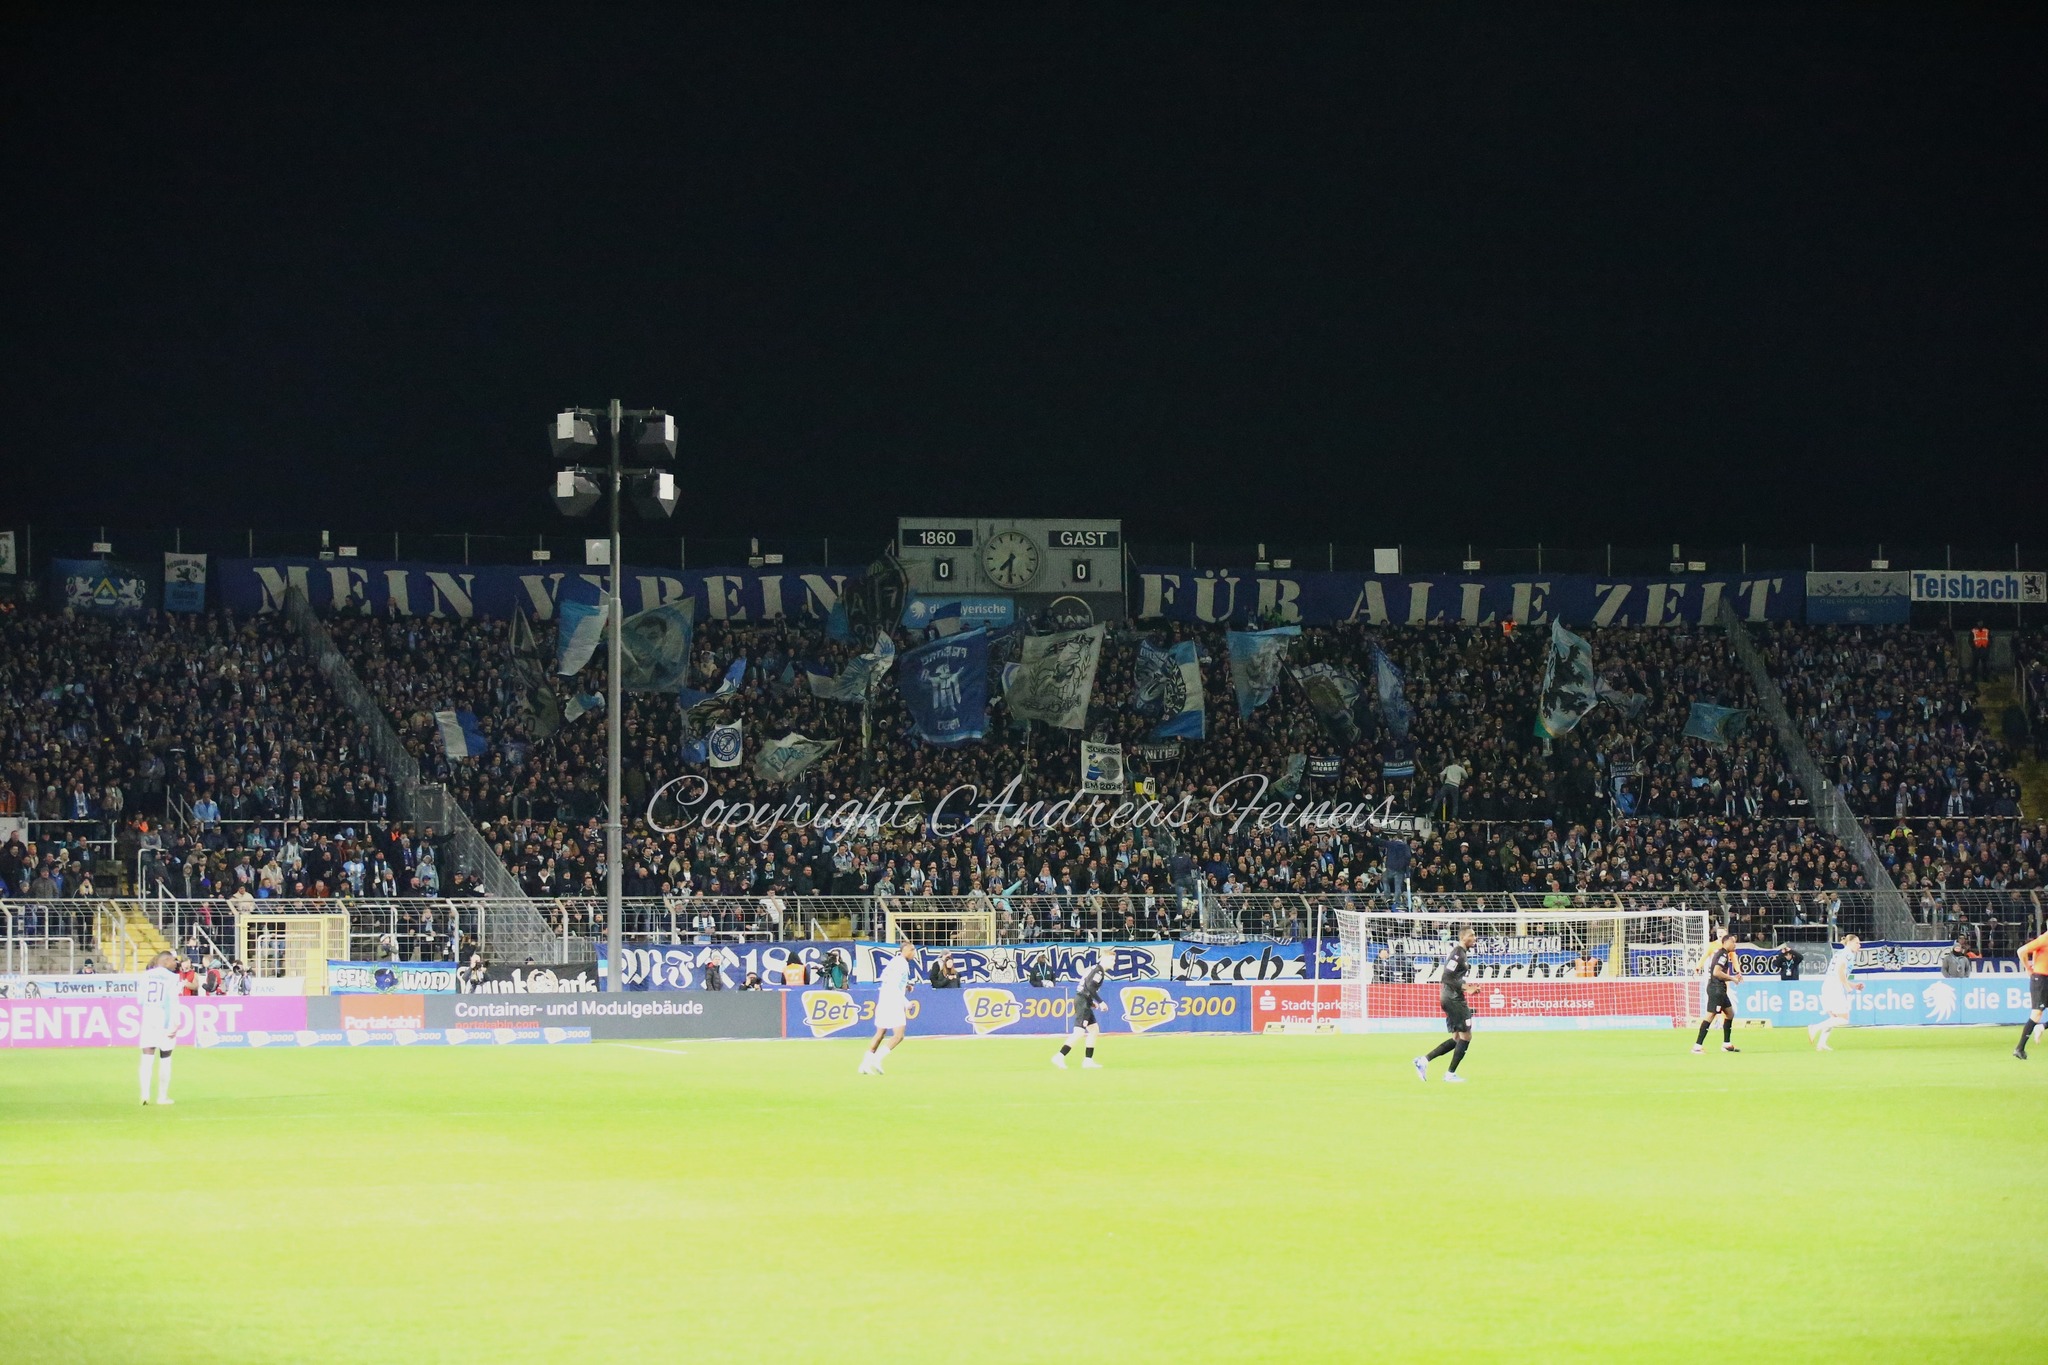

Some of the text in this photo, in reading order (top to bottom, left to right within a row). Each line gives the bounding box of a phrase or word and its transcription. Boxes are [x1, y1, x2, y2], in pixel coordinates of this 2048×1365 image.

[920, 532, 955, 546] 1860
[1060, 532, 1107, 546] GAST
[939, 563, 949, 579] 0
[1076, 565, 1086, 581] 0
[252, 565, 477, 619] MEIN
[1140, 569, 1303, 624] FÜR
[1343, 580, 1550, 627] ALLE
[1592, 578, 1782, 627] ZEIT
[1912, 574, 2017, 600] Teisbach
[868, 947, 990, 984] PNER
[55, 980, 138, 994] Löwen Fancl
[147, 981, 164, 1003] 21
[975, 998, 1014, 1018] Bet
[1130, 996, 1236, 1016] Bet 3000
[1281, 999, 1362, 1012] Stadtsparkss
[1511, 998, 1594, 1010] Stadtsparkasse
[1745, 988, 1914, 1018] die Bayrische
[1964, 987, 2001, 1009] die
[456, 1000, 703, 1018] Container- und Modulgebäude
[813, 1000, 921, 1020] Bet 30
[117, 1003, 243, 1039] SORT
[345, 1016, 421, 1030] Portakabin
